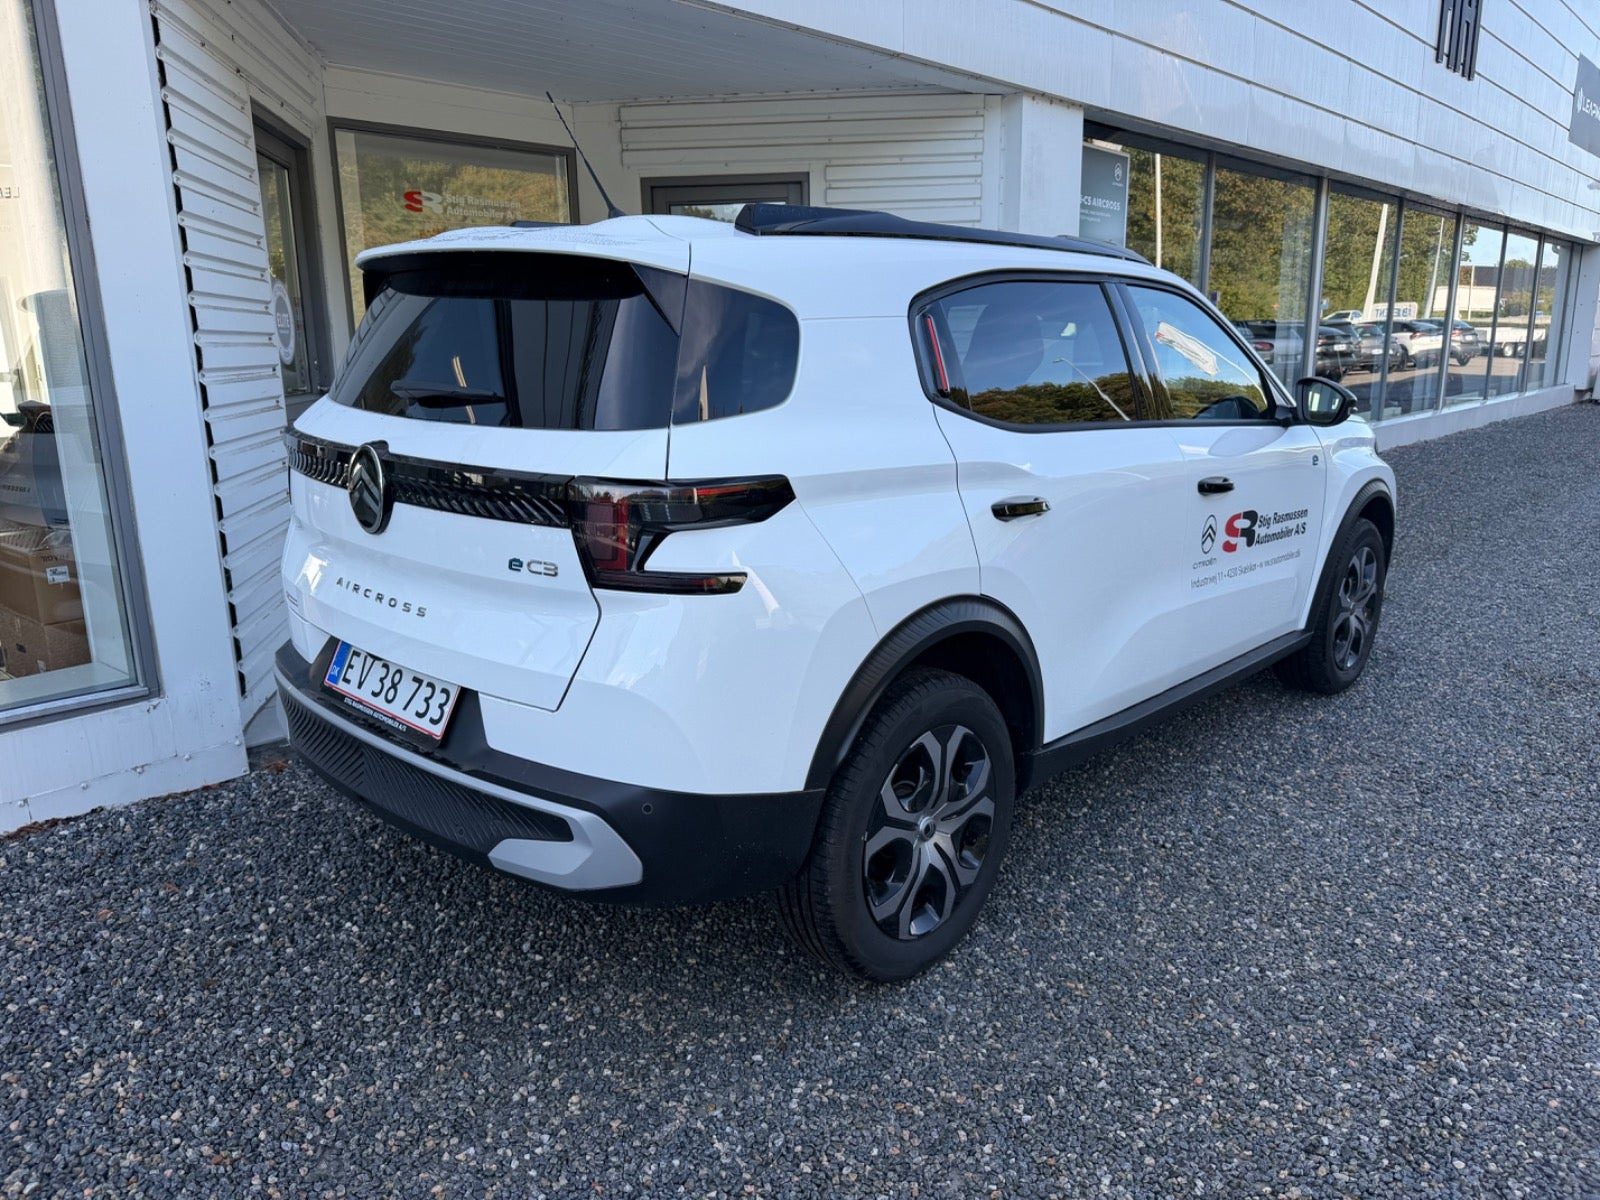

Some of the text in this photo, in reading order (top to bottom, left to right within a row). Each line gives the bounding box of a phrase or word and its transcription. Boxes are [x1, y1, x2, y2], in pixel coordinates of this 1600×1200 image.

[446, 194, 520, 209] Stig Rasmussen
[446, 206, 504, 219] Automobiler
[1258, 508, 1308, 530] Stig Rasmussen
[1255, 525, 1294, 546] Automobiler
[336, 576, 427, 617] AIRCROSS
